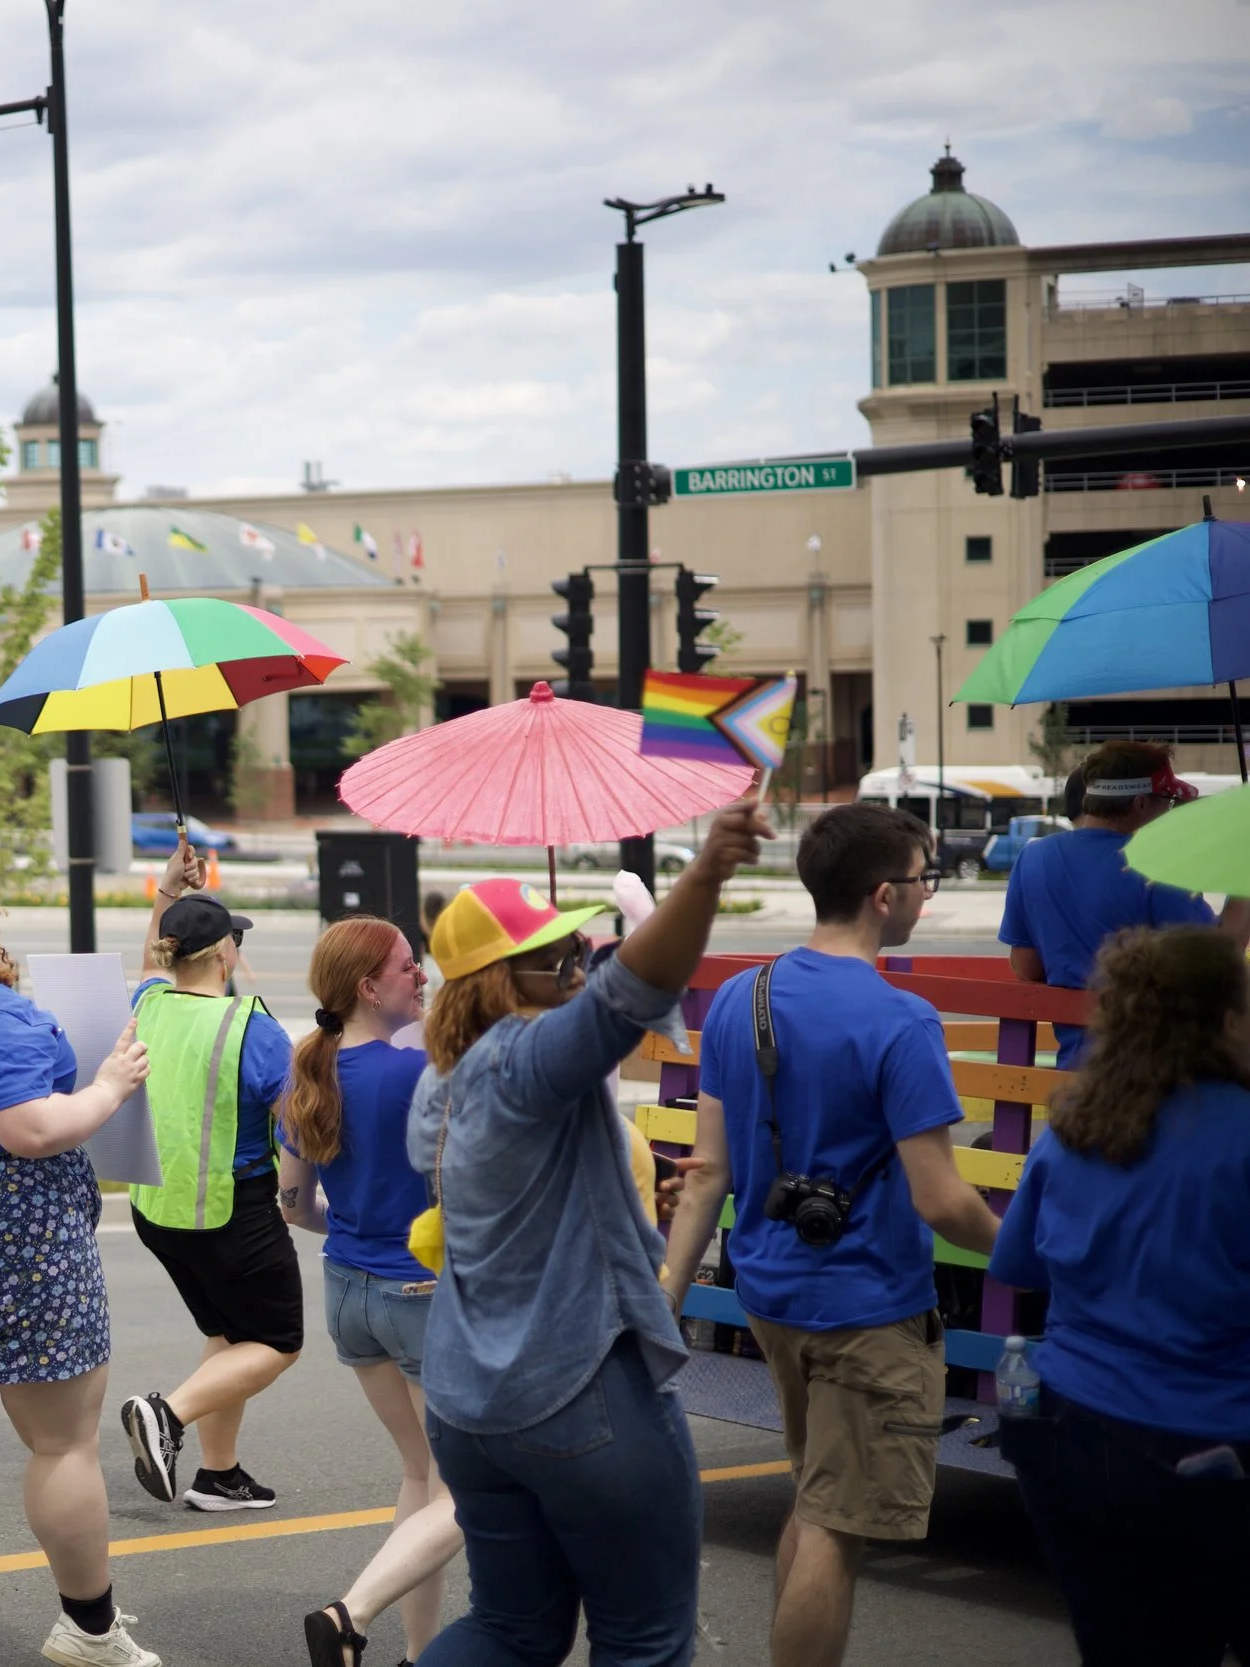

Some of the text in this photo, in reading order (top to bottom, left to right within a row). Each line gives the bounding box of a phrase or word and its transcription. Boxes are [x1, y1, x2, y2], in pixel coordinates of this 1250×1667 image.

[688, 465, 837, 492] BARRINGTON ST
[758, 975, 767, 1030] OLYMPUS
